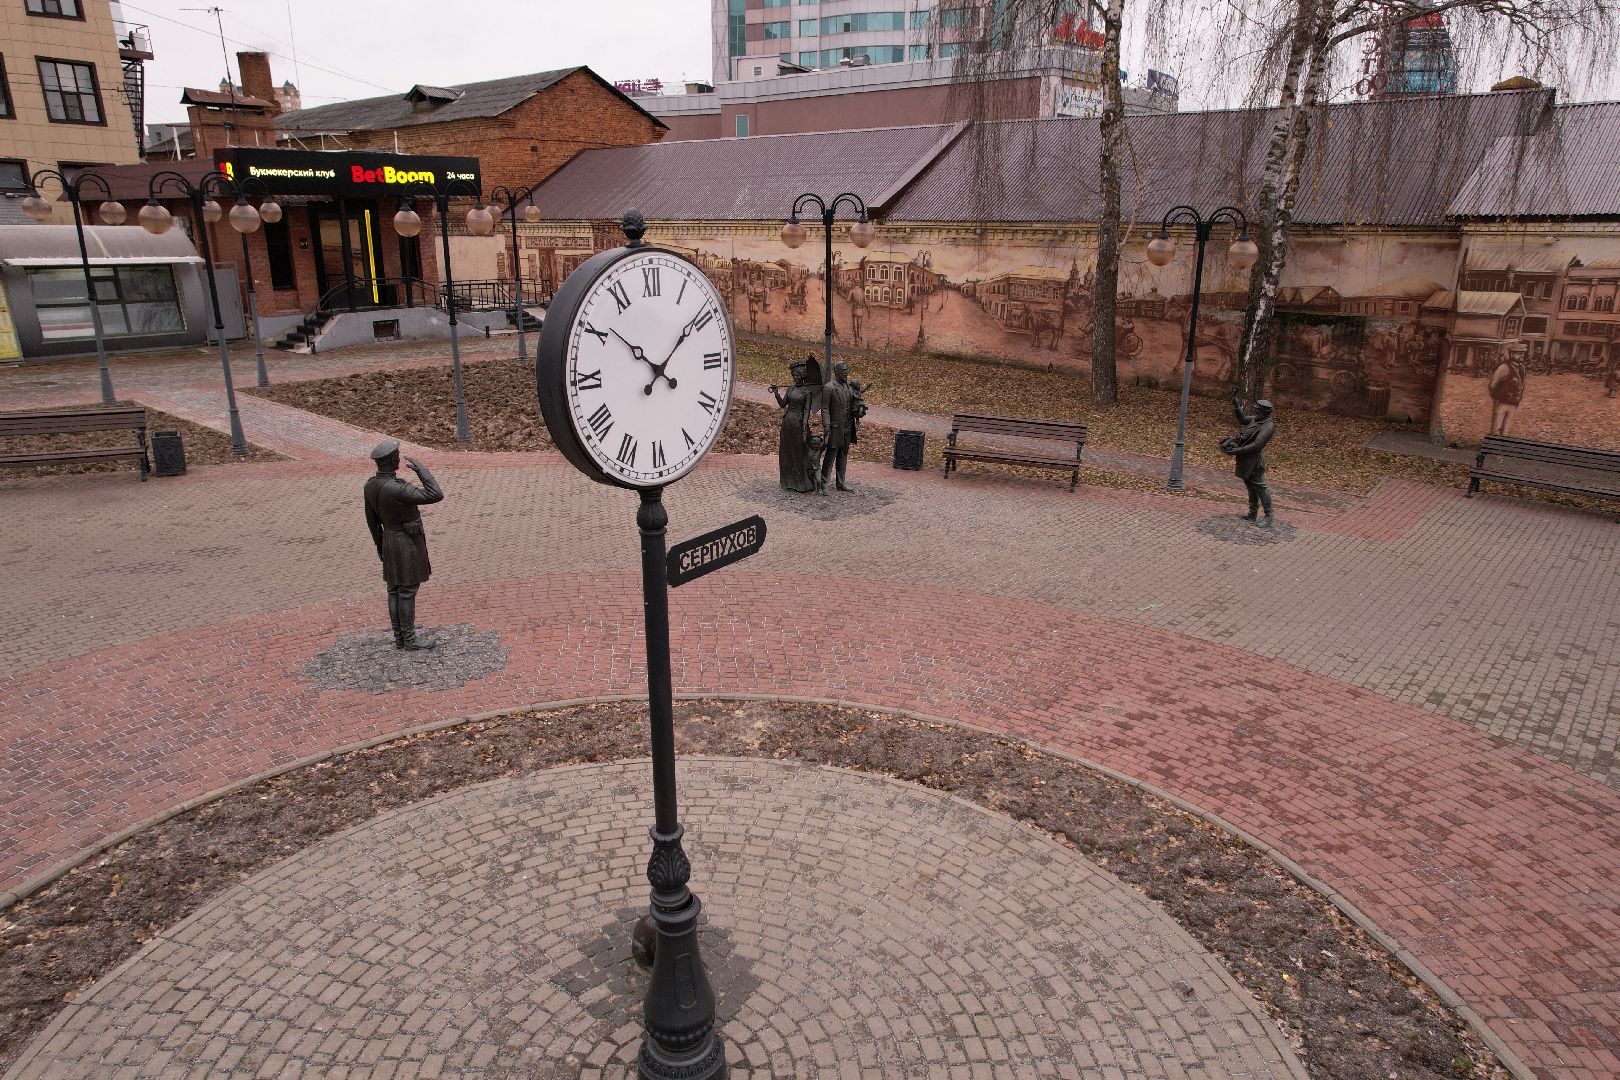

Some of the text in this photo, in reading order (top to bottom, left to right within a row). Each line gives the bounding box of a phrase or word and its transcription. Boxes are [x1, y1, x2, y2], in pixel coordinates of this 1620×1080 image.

[250, 166, 336, 178] Букмекерский клуб
[351, 165, 435, 184] BetBoom
[446, 171, 475, 180] 24 часа
[642, 267, 661, 297] XII
[676, 277, 688, 305] I
[606, 279, 632, 315] XI
[694, 309, 713, 332] II
[584, 321, 609, 346] X
[703, 352, 722, 370] III
[577, 368, 602, 391] IX
[697, 390, 717, 415] IV
[587, 402, 615, 443] VIII
[616, 432, 638, 468] VII
[681, 427, 695, 450] V
[651, 440, 667, 468] VI
[680, 526, 756, 571] СЕРПУХОВ
